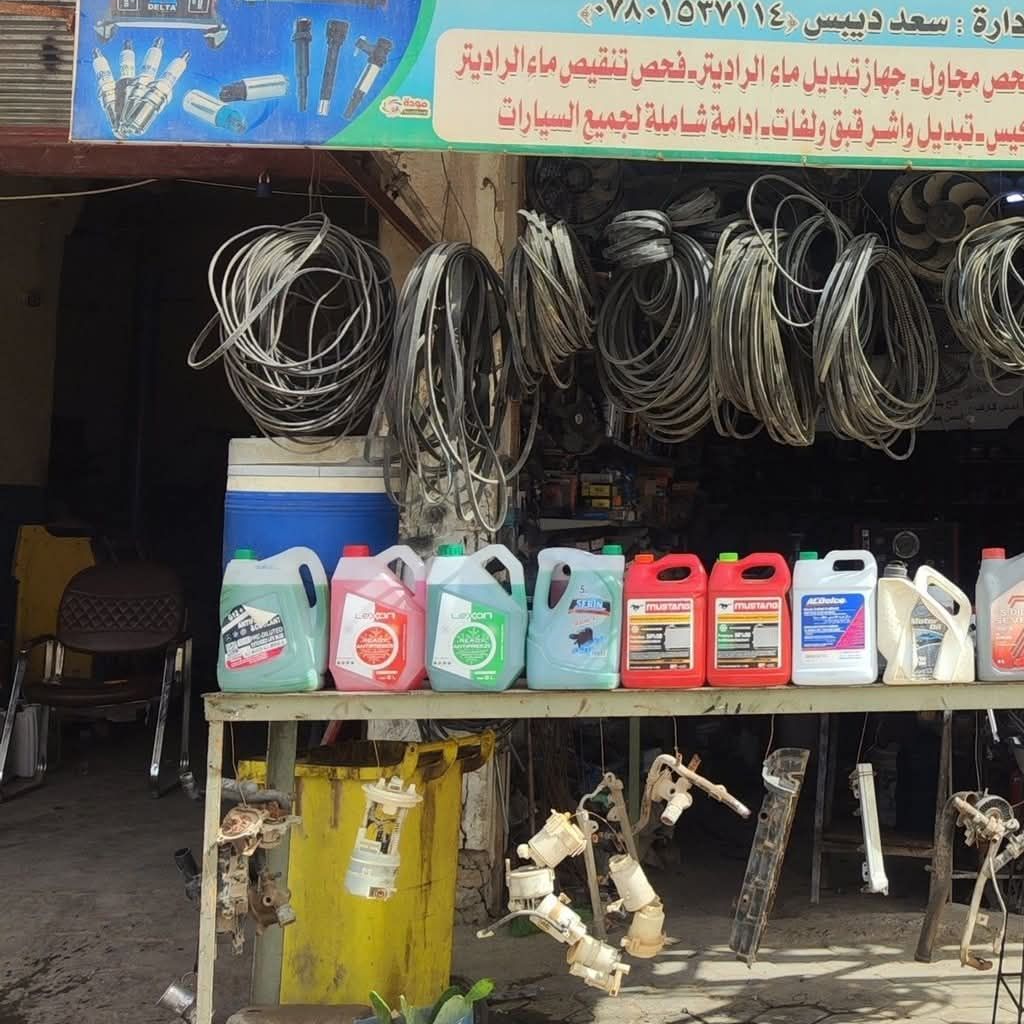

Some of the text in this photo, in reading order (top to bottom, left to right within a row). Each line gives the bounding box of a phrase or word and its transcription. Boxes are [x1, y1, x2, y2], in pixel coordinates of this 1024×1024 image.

[147, 3, 177, 11] DELTA
[890, 8, 949, 33] سعد
[498, 97, 580, 136] السيارات
